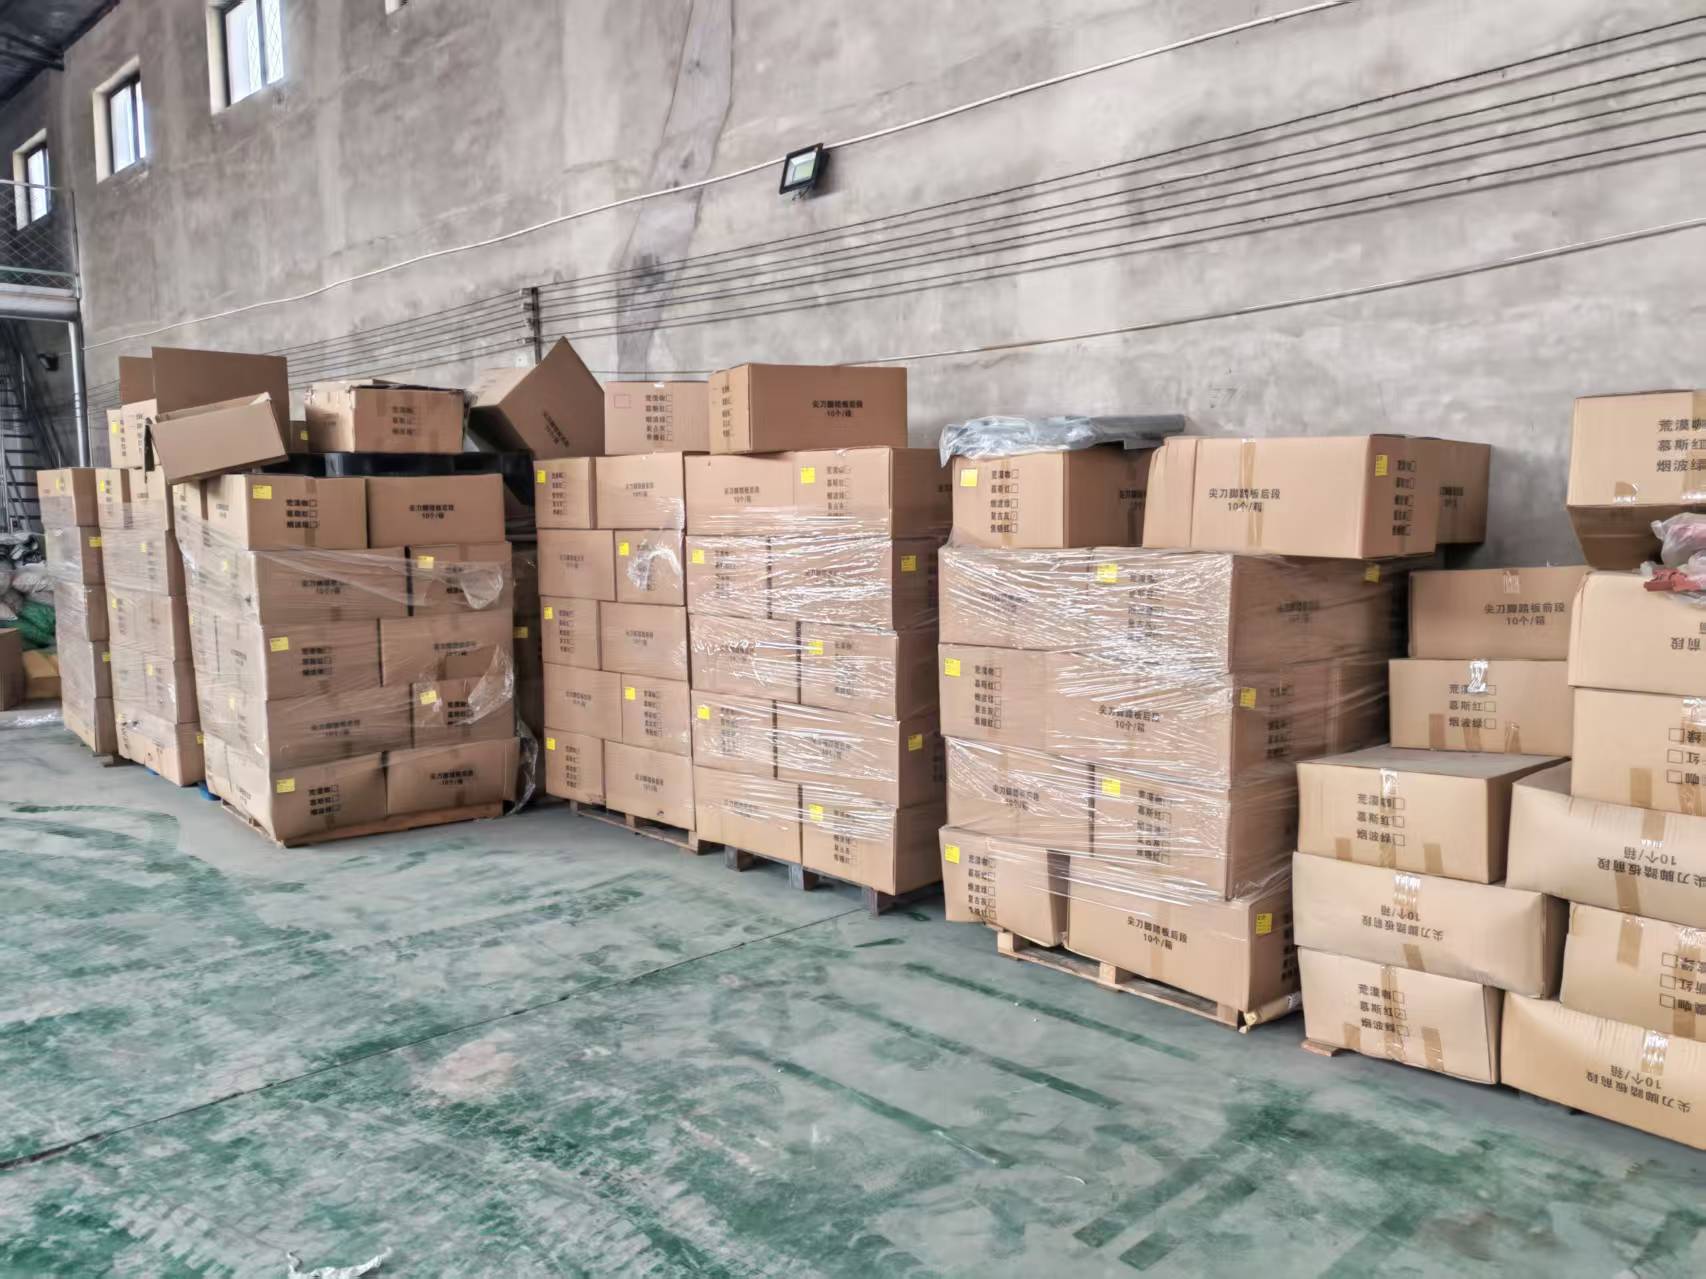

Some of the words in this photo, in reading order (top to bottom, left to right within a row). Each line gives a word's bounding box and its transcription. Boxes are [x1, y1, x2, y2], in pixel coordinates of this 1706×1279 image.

[1484, 602, 1565, 614] 尖刀脚踏板前段
[1505, 616, 1545, 626] 10个/箱
[1623, 846, 1678, 865] 10个/箱
[1380, 904, 1421, 922] 10个/箱
[1610, 1064, 1662, 1090] 10个/箱
